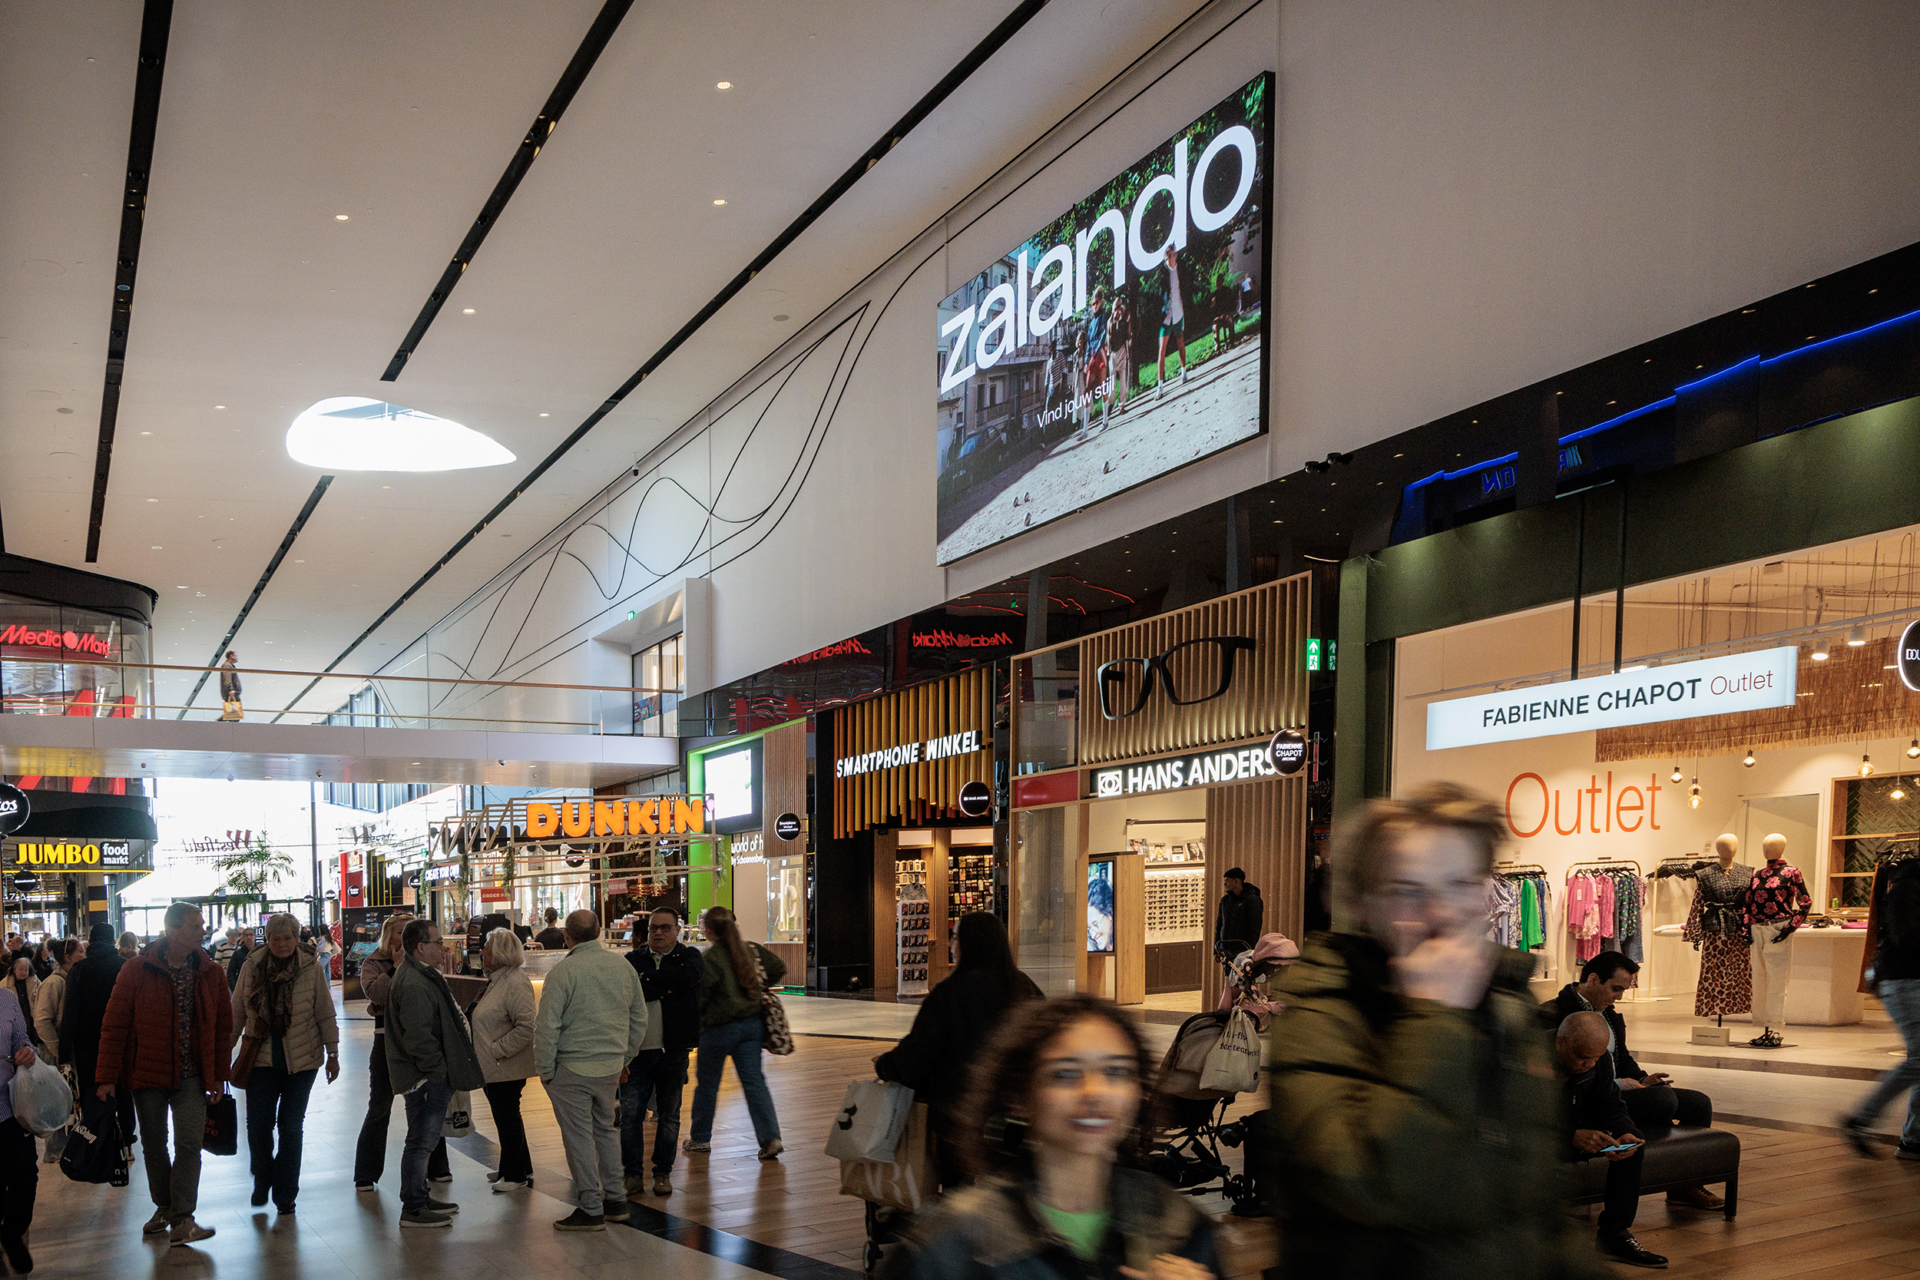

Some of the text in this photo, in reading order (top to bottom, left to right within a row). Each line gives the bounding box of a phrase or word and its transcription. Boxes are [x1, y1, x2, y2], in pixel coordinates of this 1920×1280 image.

[940, 125, 1257, 394] zalando
[1037, 375, 1115, 428] Vind jouw stijl
[0, 625, 62, 647] Media
[1483, 670, 1774, 728] FABIENNE CHAPOT Outlet
[836, 730, 980, 778] SMARTPHONE WINKEL
[1275, 749, 1303, 757] CHAPOT
[1128, 760, 1184, 794] HANS
[1505, 770, 1662, 838] Outlet
[15, 843, 129, 865] JUMBO food
[103, 856, 129, 865] markt
[731, 836, 749, 854] world
[750, 834, 758, 852] of
